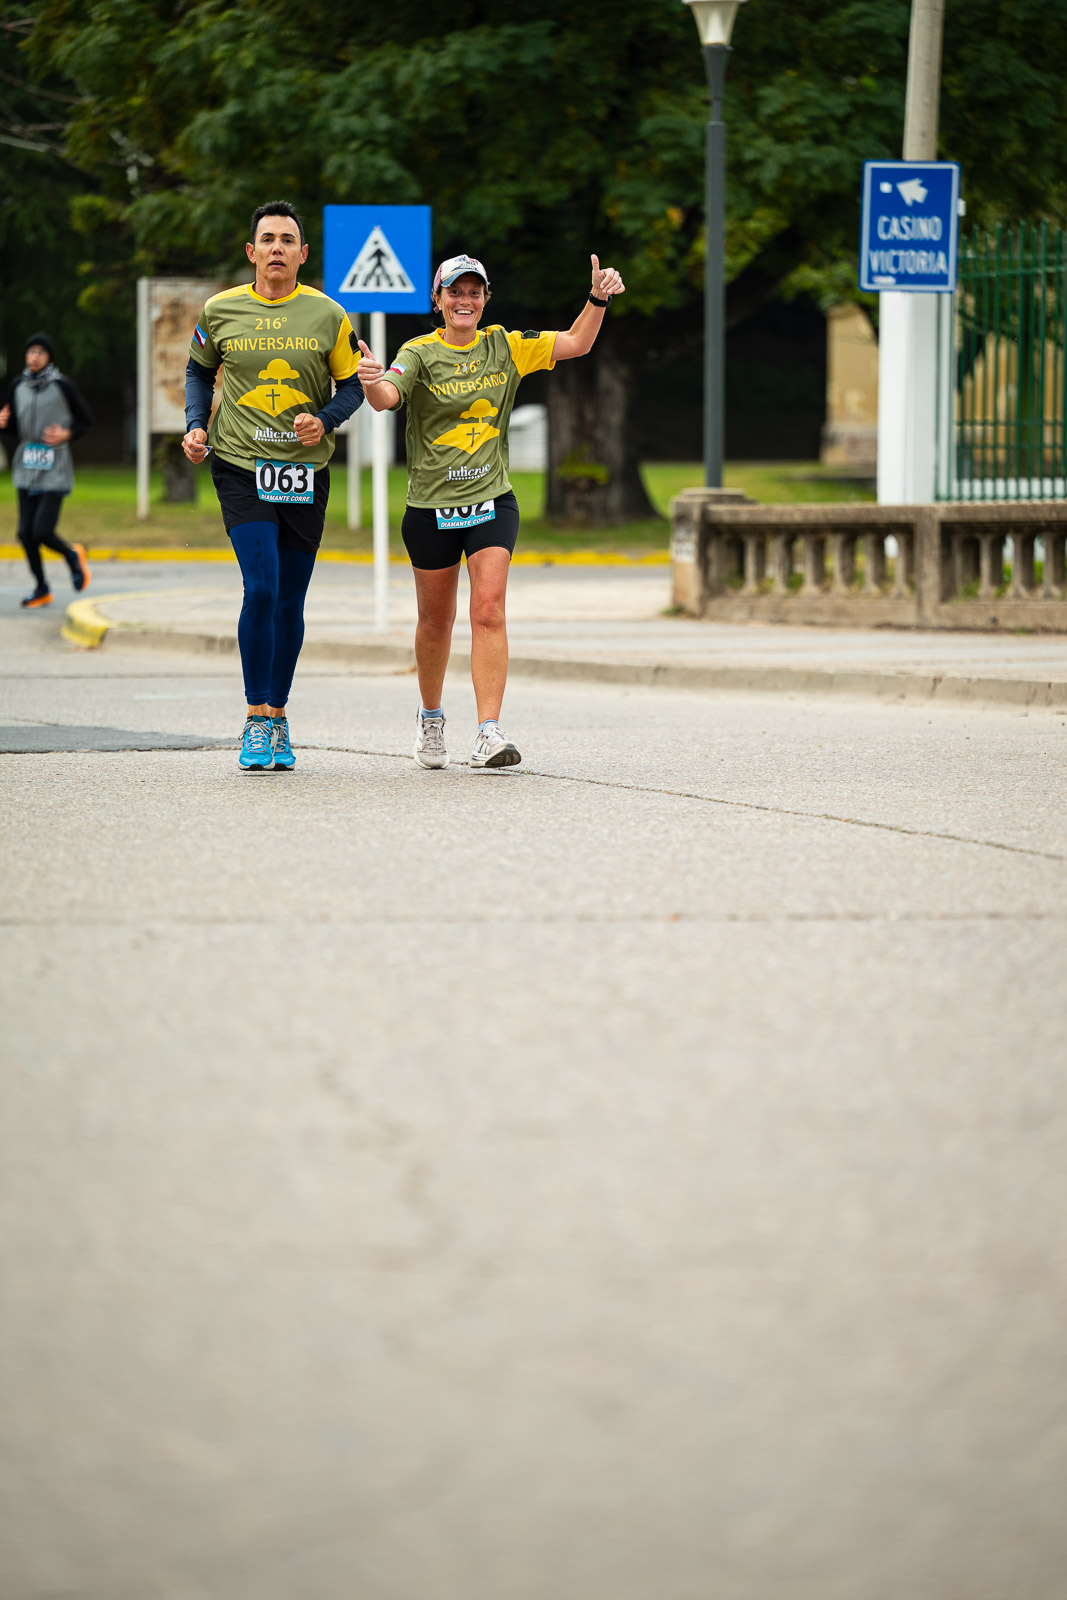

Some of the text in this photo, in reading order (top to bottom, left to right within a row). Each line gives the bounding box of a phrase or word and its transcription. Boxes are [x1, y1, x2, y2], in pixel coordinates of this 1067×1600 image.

[877, 215, 943, 241] CASINO
[869, 249, 949, 275] VICTORIA
[255, 317, 288, 330] 216°
[226, 337, 319, 351] ANIVERSARIO
[429, 371, 508, 396] ANIVERSARIO
[260, 462, 308, 494] 063
[261, 493, 290, 502] DIAMANTE
[440, 520, 472, 528] DIAMANTE
